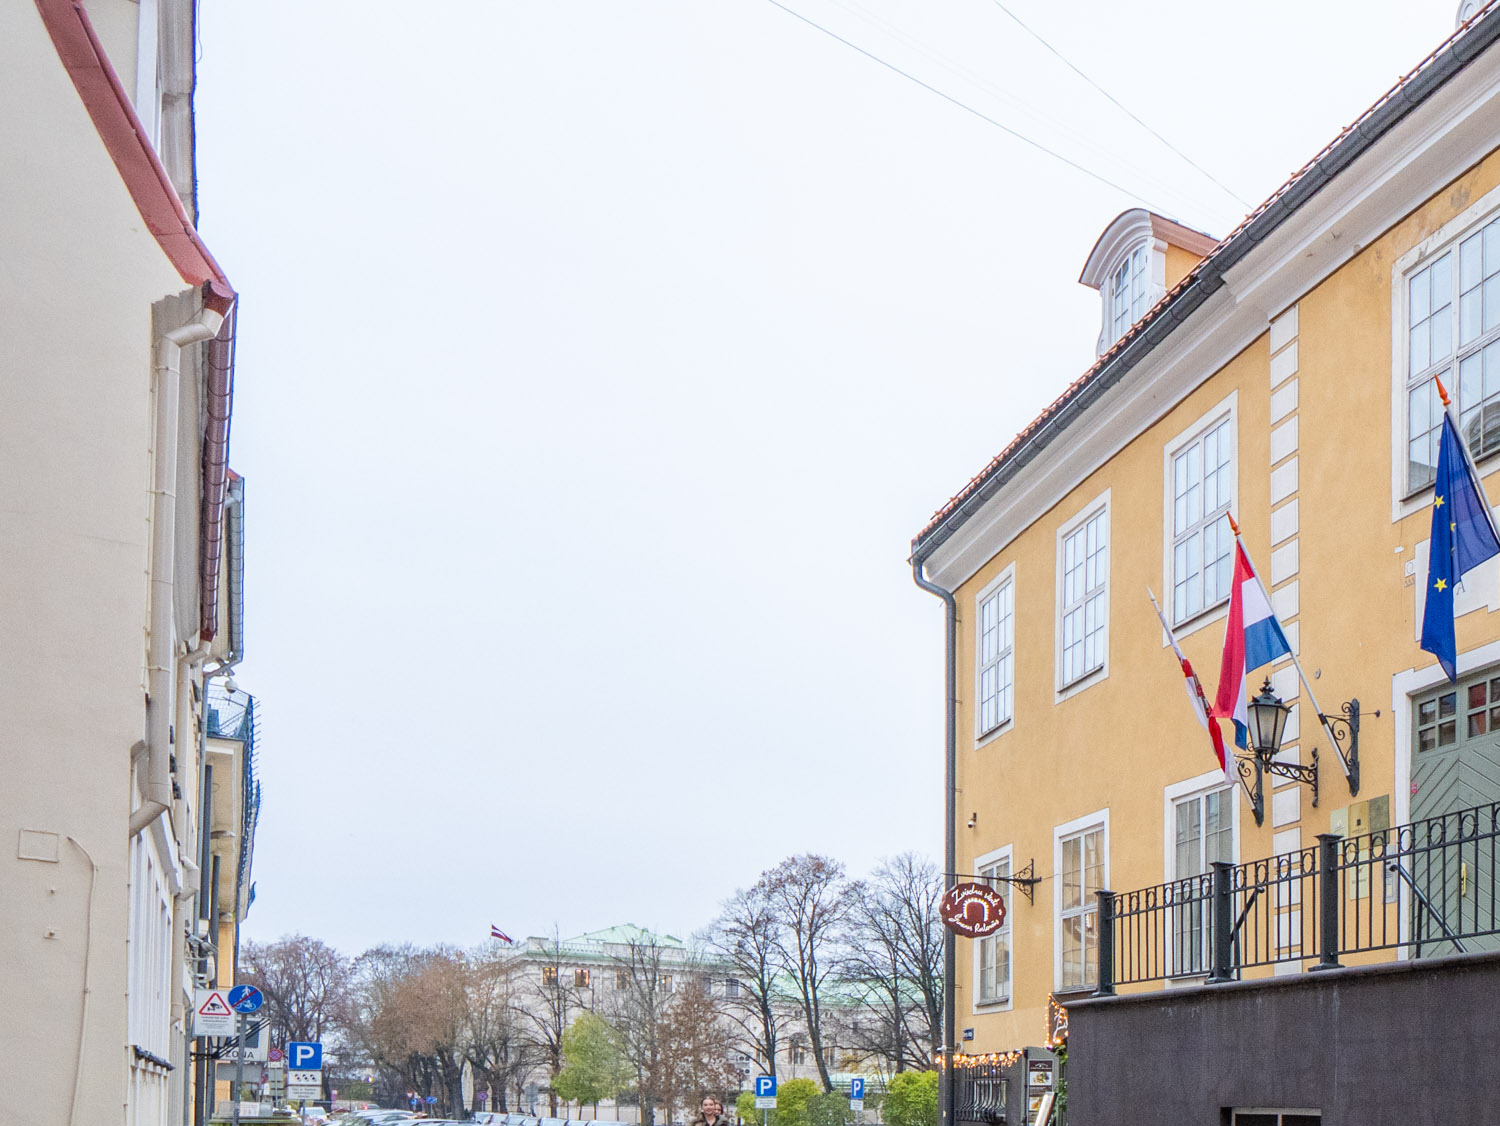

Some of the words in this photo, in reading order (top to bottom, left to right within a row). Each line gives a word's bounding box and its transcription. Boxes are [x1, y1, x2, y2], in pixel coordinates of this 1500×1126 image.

[296, 1046, 314, 1066] P
[760, 1079, 772, 1095] P
[853, 1081, 861, 1097] P
